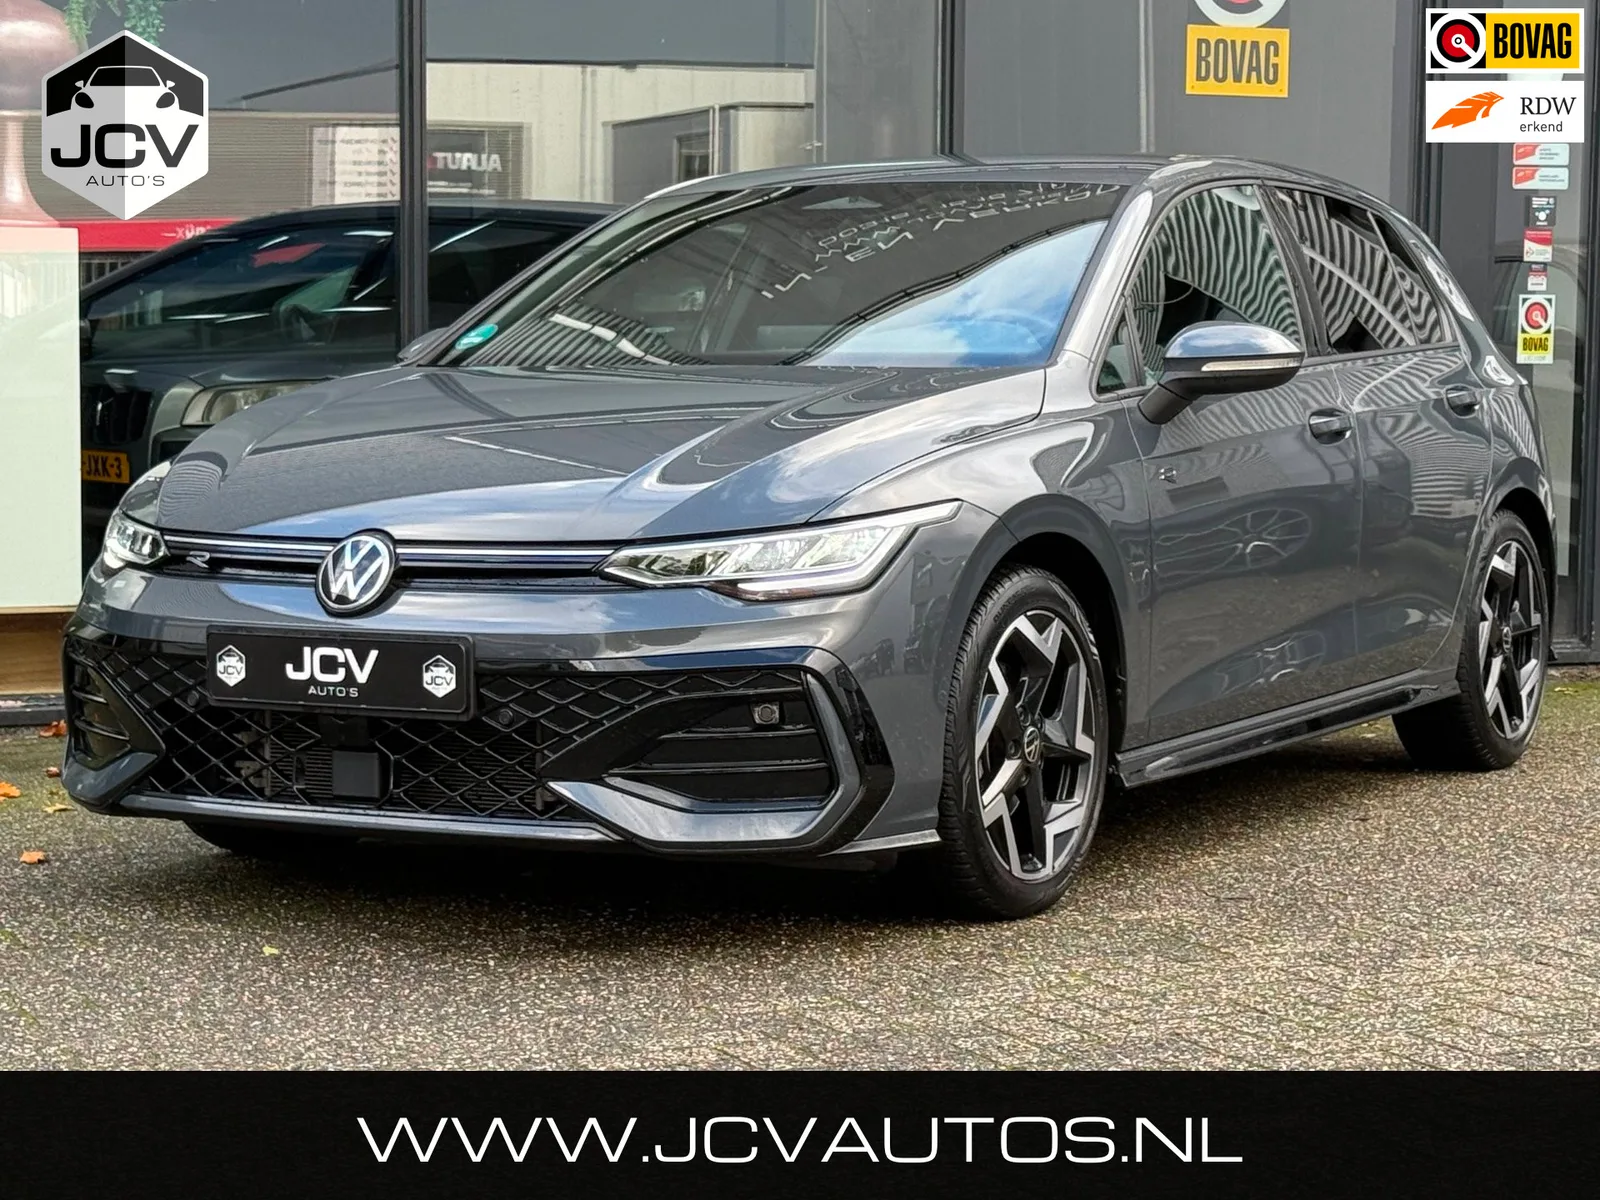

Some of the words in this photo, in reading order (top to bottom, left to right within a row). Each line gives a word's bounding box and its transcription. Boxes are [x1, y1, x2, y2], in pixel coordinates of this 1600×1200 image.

[1196, 38, 1280, 85] BOVAG
[1522, 337, 1548, 352] BOVAG
[218, 665, 243, 676] JCV
[285, 646, 379, 684] JCV
[425, 675, 453, 686] JCV
[308, 685, 359, 698] AUTO'S
